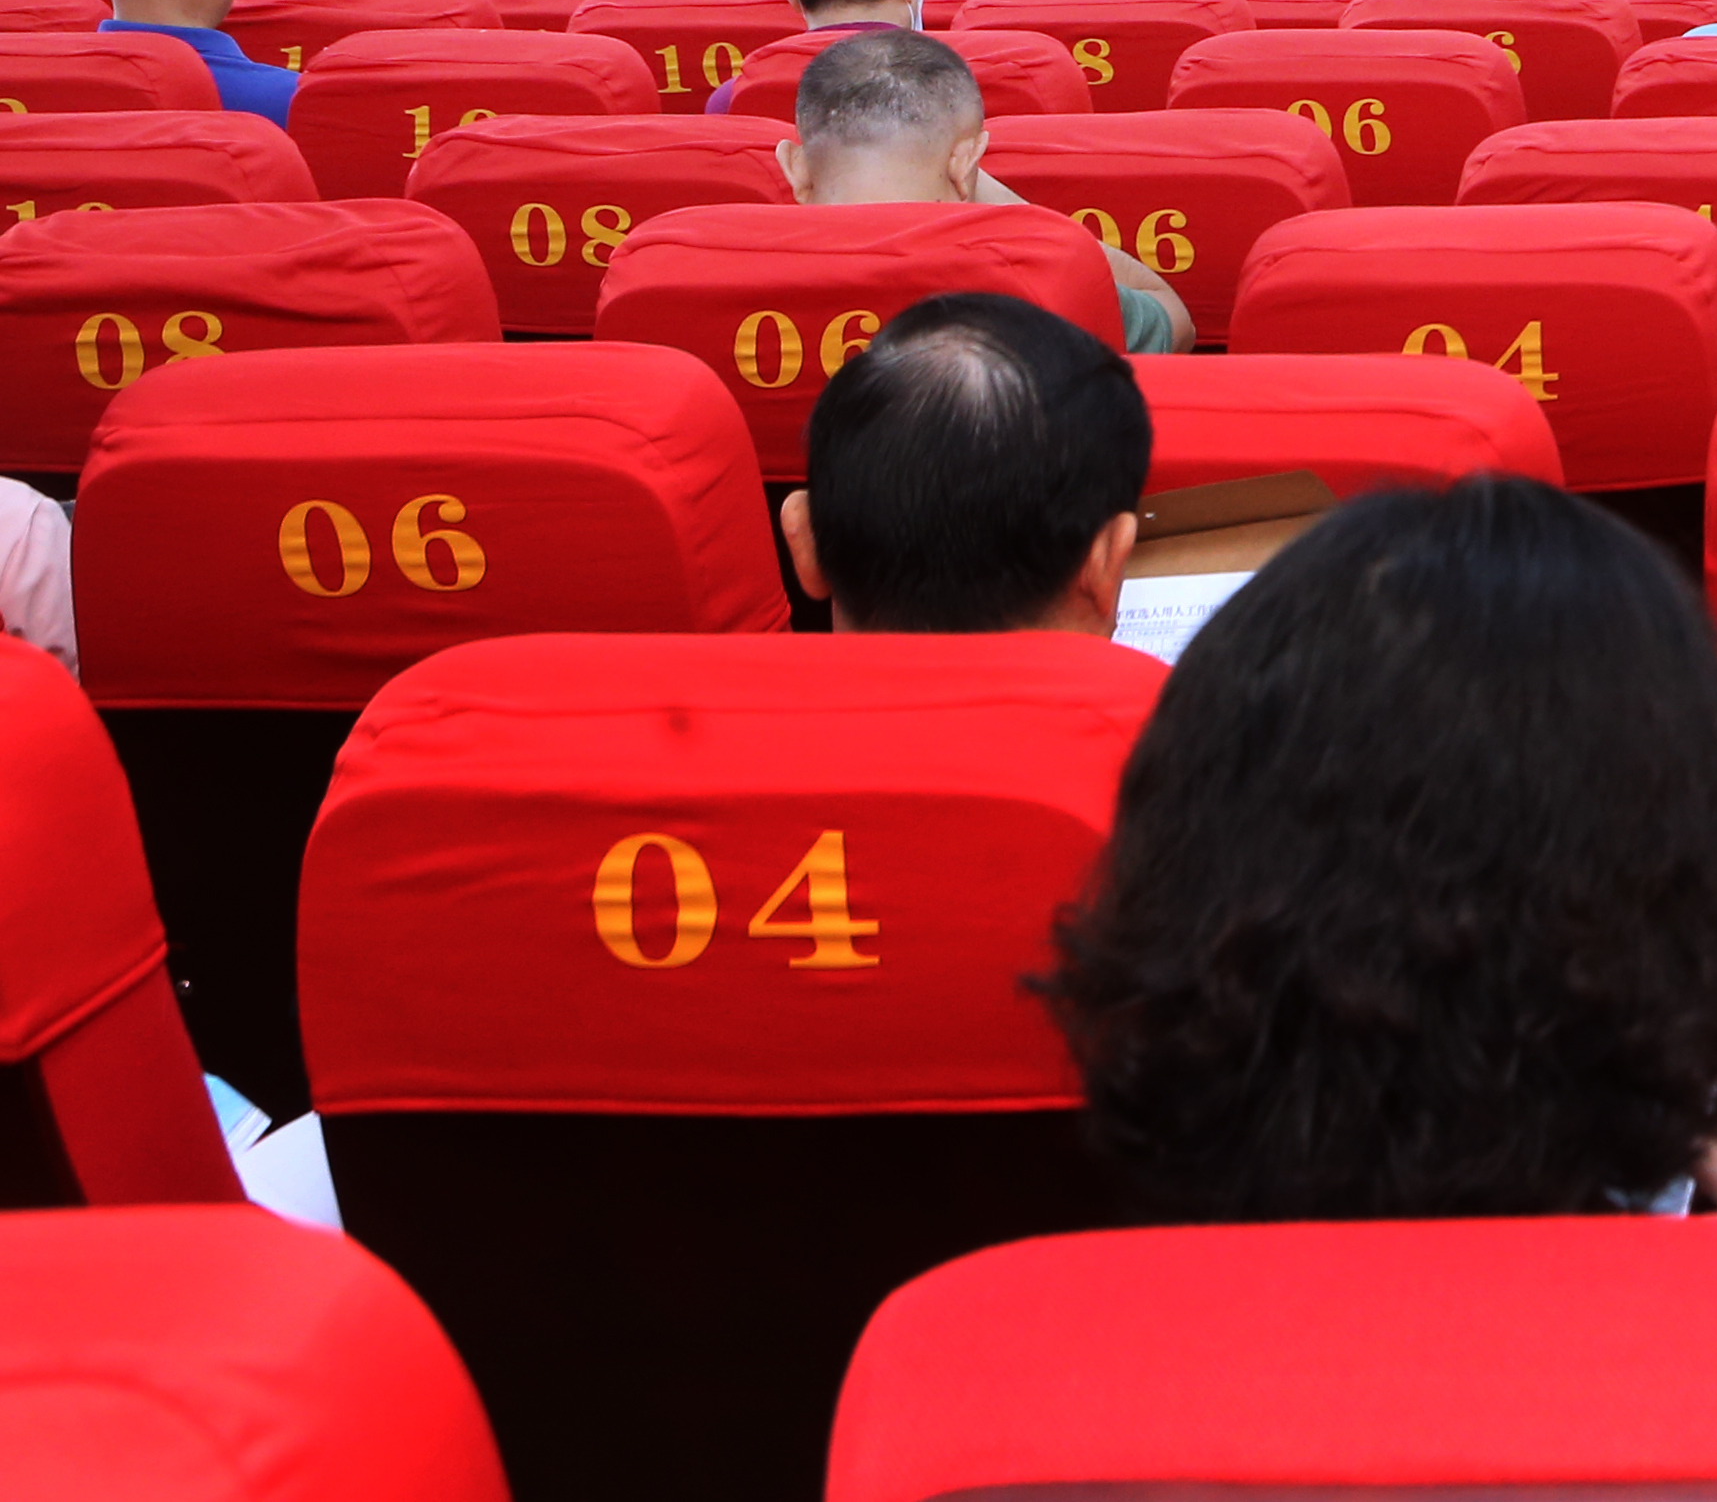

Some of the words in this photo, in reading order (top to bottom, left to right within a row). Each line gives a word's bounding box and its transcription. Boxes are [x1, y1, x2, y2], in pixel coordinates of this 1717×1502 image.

[655, 41, 745, 94] 10
[402, 104, 497, 159] 1
[509, 202, 632, 267] 08
[76, 310, 223, 390] 08
[735, 309, 881, 388] 06
[279, 494, 487, 596] 06
[592, 830, 880, 971] 04
